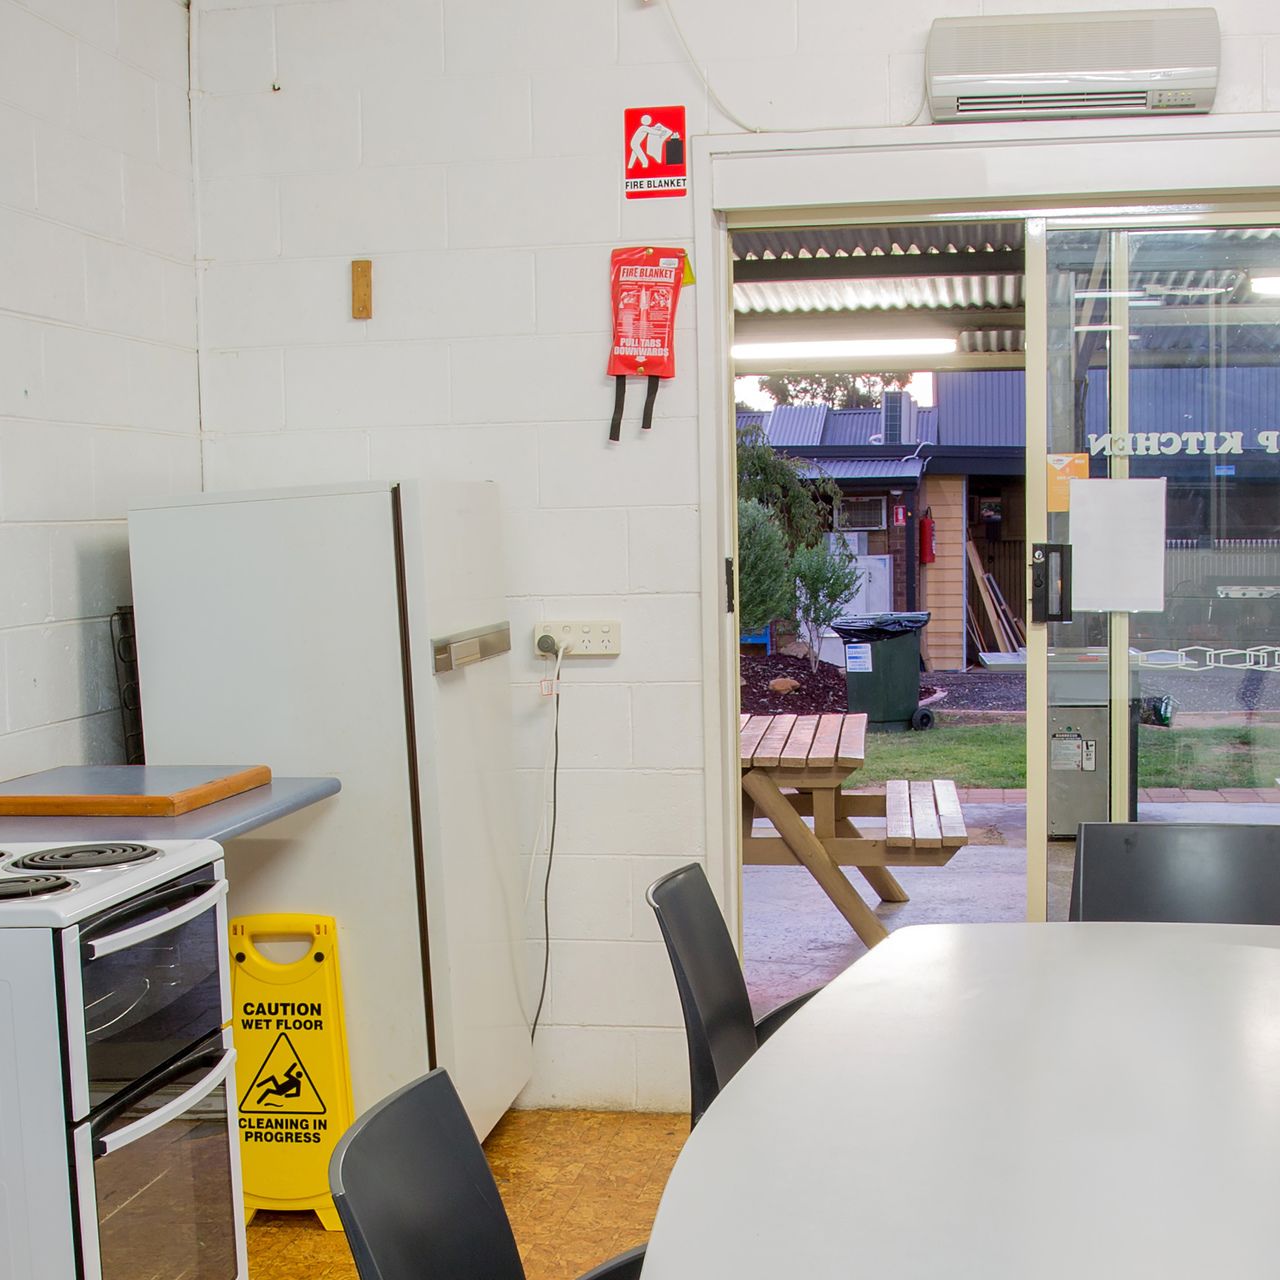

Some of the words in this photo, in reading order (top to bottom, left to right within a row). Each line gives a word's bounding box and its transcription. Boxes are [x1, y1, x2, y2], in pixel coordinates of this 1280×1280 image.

[625, 181, 644, 189] FIRE
[647, 178, 687, 189] BLANKET
[621, 267, 639, 278] FIRE
[640, 267, 674, 279] BLANKET
[620, 337, 639, 347] PULL
[640, 338, 661, 348] TABS
[613, 345, 669, 357] DOWNWARDS
[243, 1002, 322, 1016] CAUTION
[241, 1019, 273, 1030] WET
[276, 1019, 323, 1030] FLOOR
[238, 1118, 309, 1131] CLEANING
[313, 1119, 328, 1131] IN
[244, 1131, 322, 1144] PROGRESS
